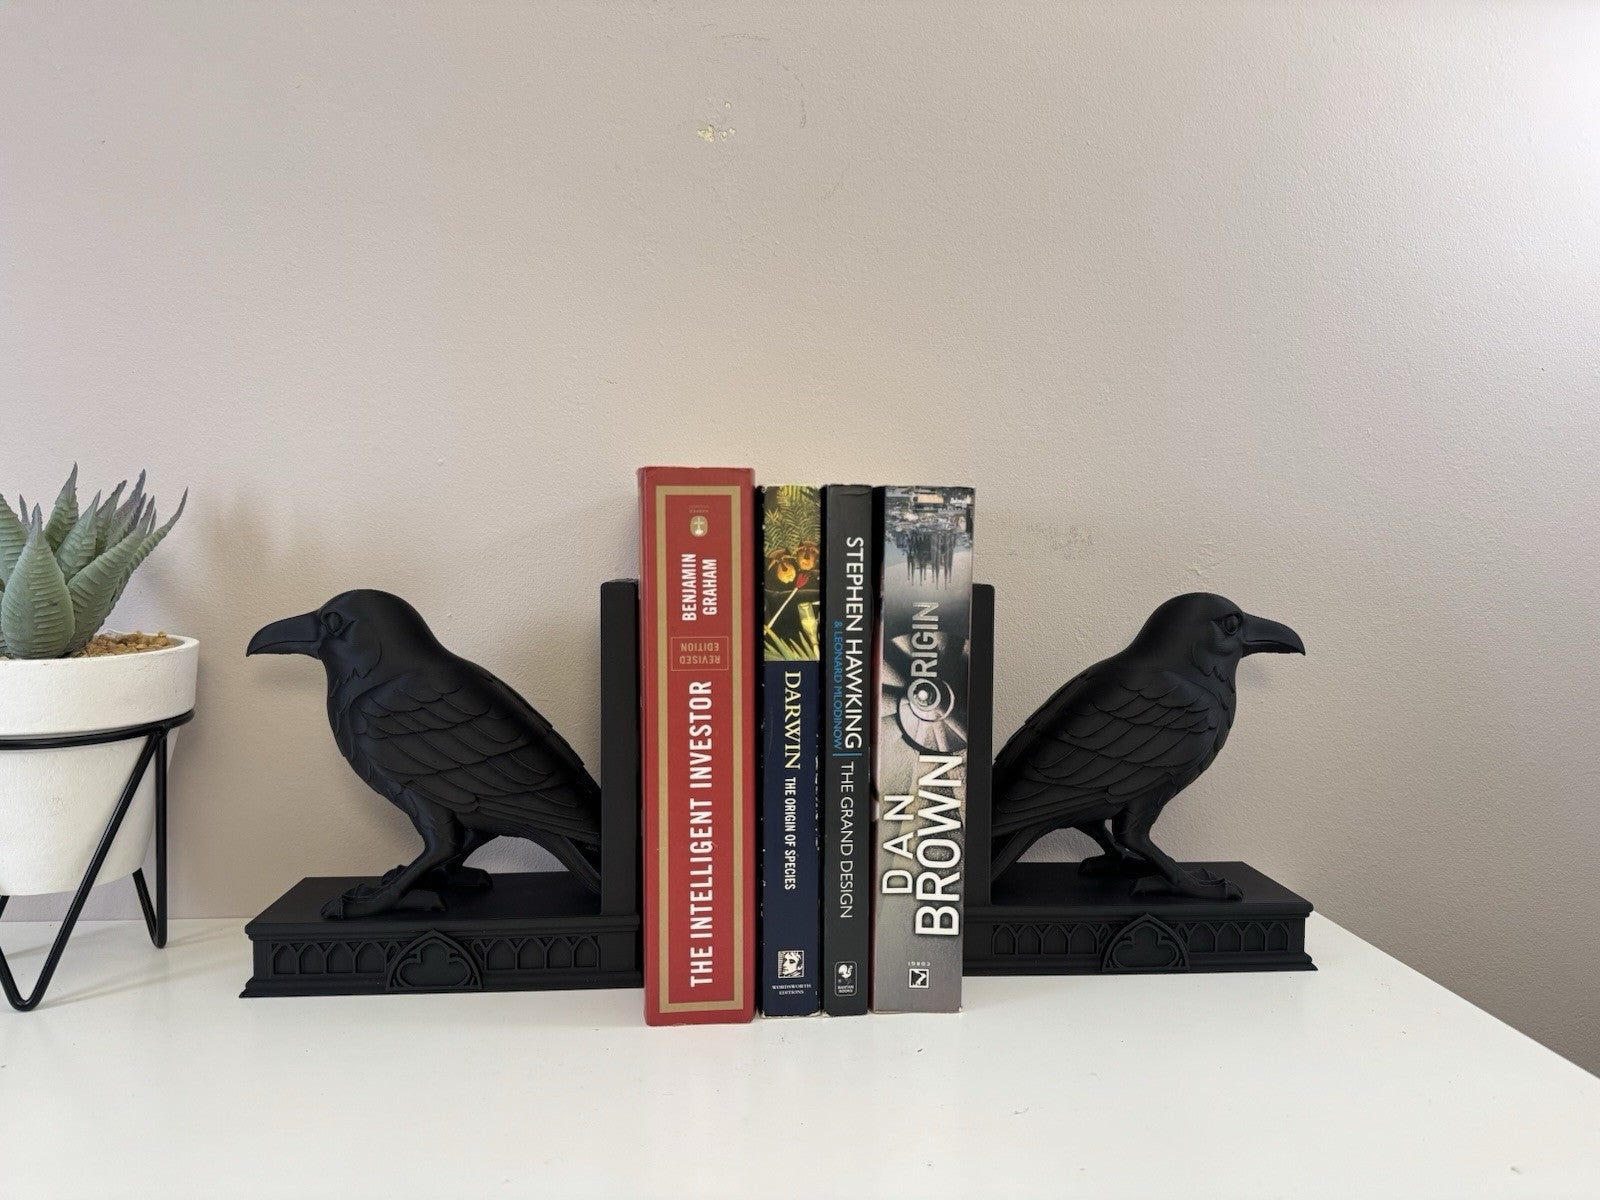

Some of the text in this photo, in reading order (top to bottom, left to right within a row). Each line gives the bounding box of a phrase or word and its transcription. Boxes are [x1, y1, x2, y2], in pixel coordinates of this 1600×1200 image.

[681, 553, 697, 621] BENJAMIN
[701, 558, 718, 616] GRAHAM
[679, 655, 721, 665] REVISED
[680, 642, 720, 652] EDITION
[833, 620, 843, 750] & LEONARD MLODINOW
[844, 536, 865, 749] STEPHEN HAWKING
[908, 602, 941, 711] ORIGIN
[784, 670, 802, 770] DARWIN
[688, 681, 713, 988] THE INTELLIGENT INVESTOR
[784, 776, 797, 891] THE ORIGIN OF SPECIES
[839, 761, 854, 919] THE GRAND DESIGN
[881, 794, 915, 895] DAN
[915, 754, 963, 936] BROWN
